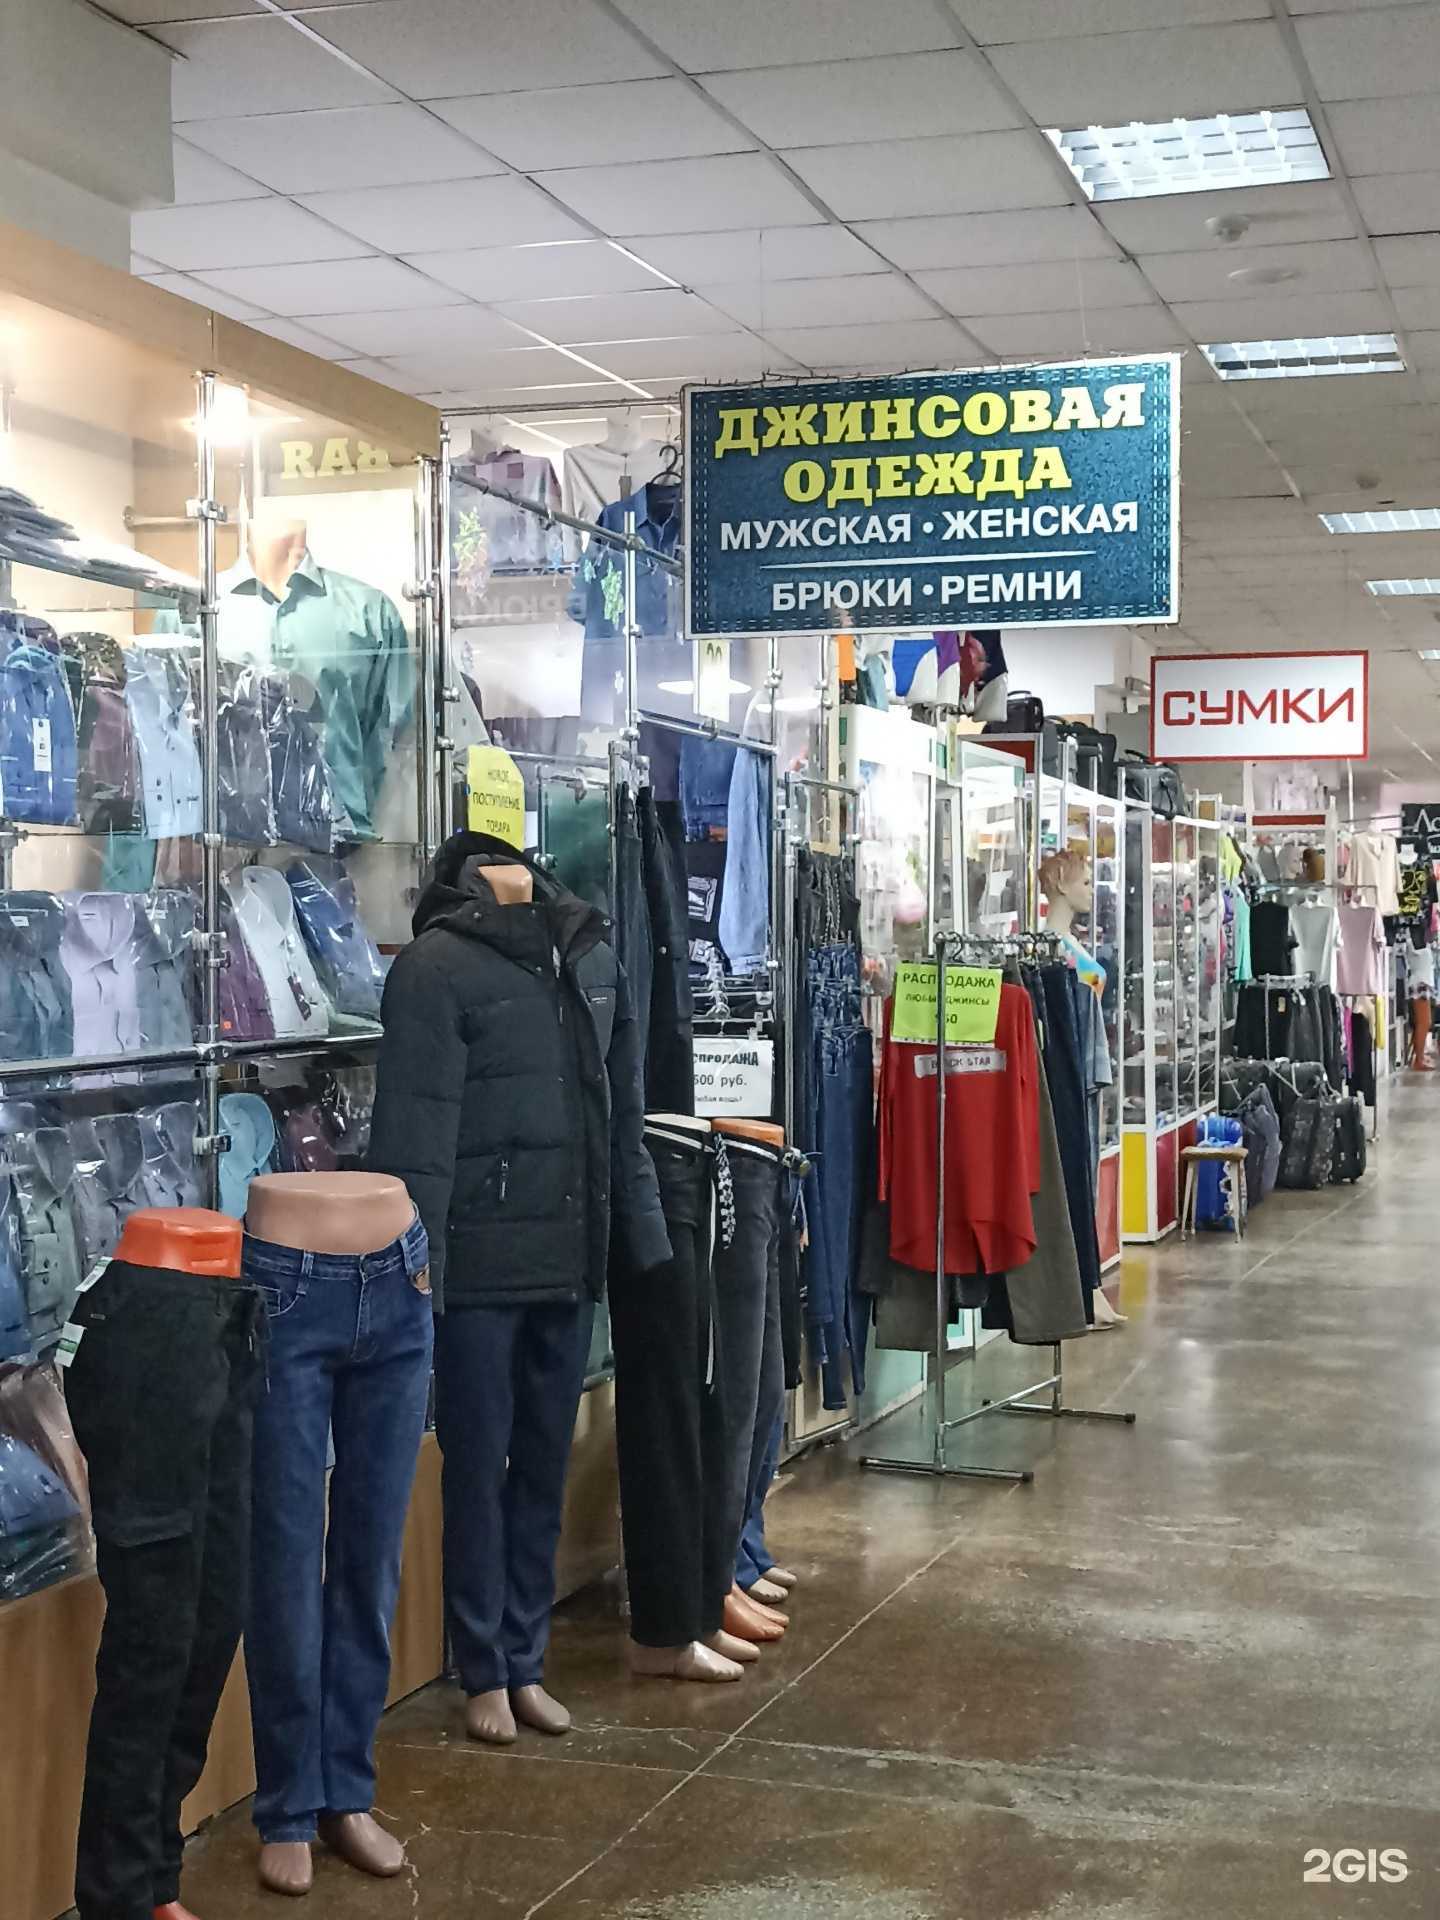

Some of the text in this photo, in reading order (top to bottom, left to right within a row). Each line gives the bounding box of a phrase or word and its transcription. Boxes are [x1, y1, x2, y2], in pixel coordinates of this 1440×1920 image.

[714, 382, 1146, 458] ДЖИНСОВАЯ
[783, 446, 1072, 509] ОДЕЖДА
[720, 501, 1139, 551] МУЖСКАЯ ЖЕНСКАЯ
[772, 570, 1083, 612] БРЮКИ РЕМНИ
[1163, 687, 1354, 726] СУМКИ
[903, 973, 995, 988] РАСПОДАЖА
[720, 1073, 748, 1088] руб.
